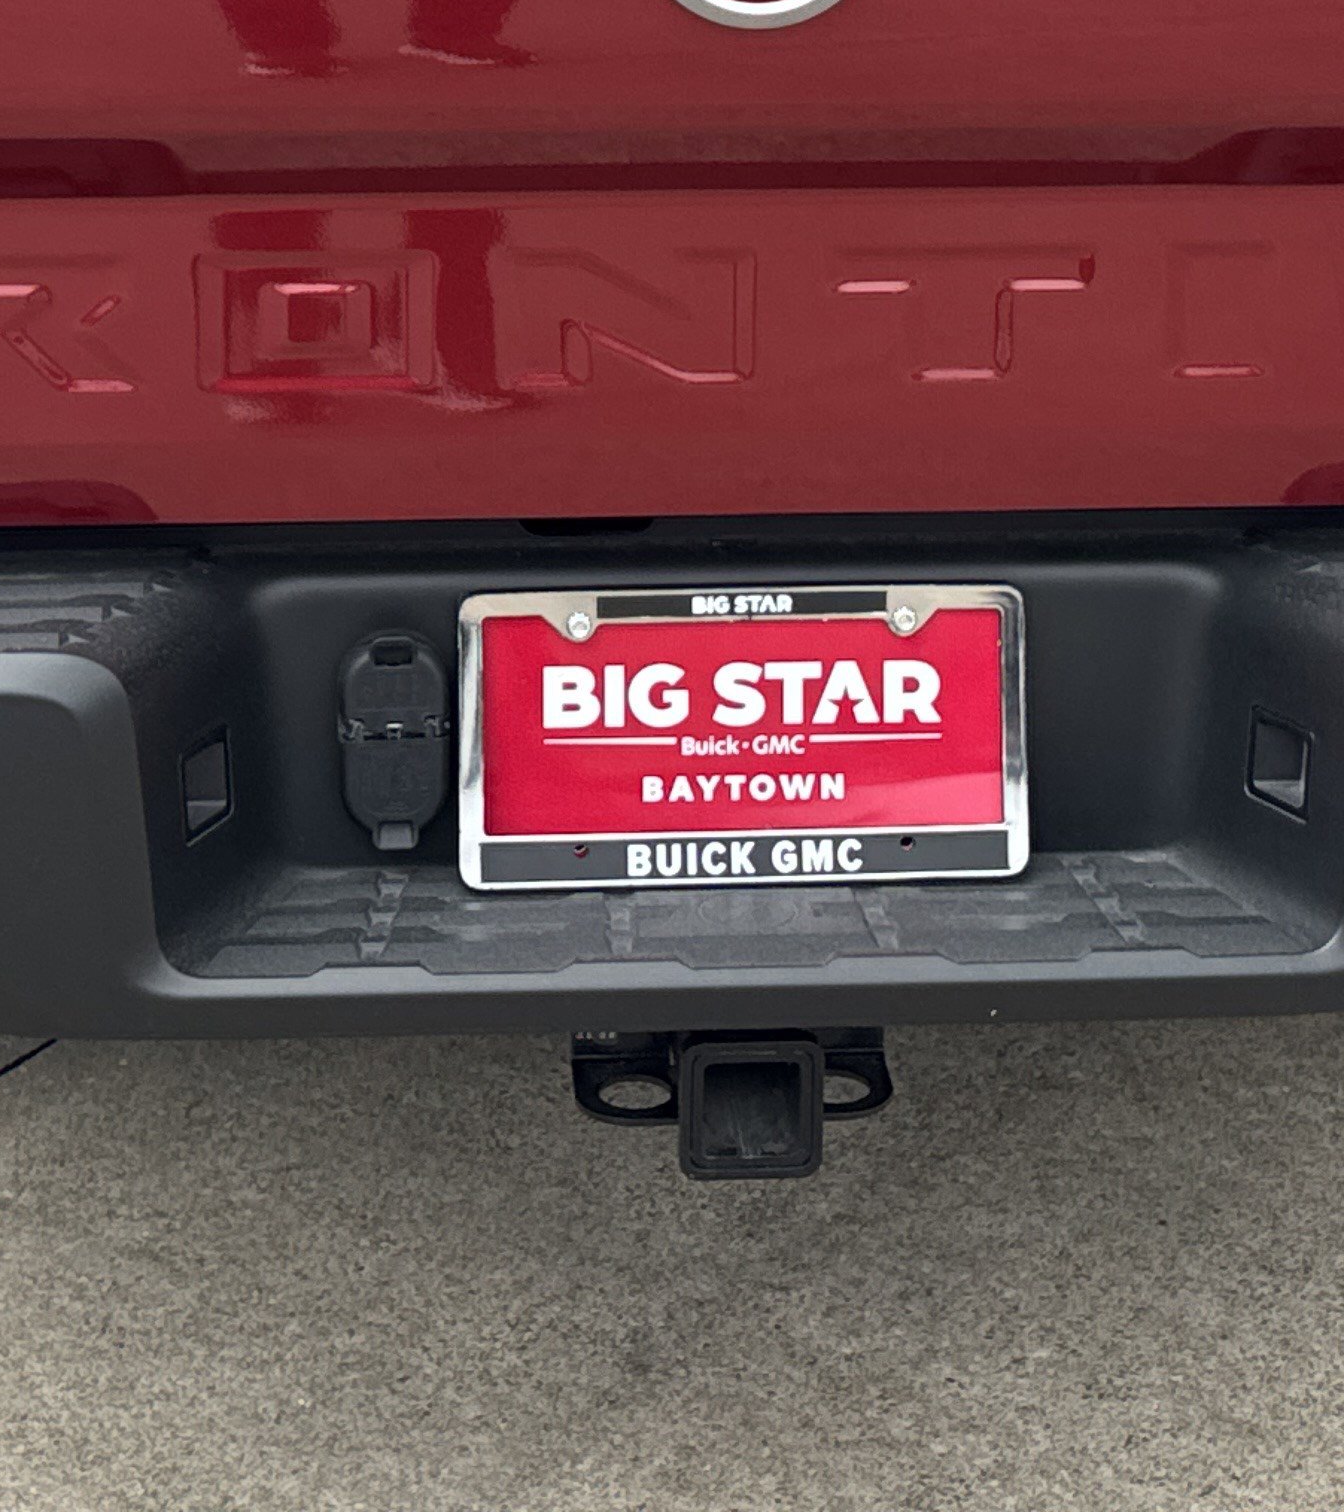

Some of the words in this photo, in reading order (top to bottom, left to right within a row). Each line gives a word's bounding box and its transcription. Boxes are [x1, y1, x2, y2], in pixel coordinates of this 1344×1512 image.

[692, 595, 731, 615] BIG
[733, 594, 793, 614] STAR
[541, 662, 690, 729] BIG
[712, 659, 943, 727] STAR
[641, 773, 846, 803] BAYTOWN
[626, 841, 756, 877] BUICK
[772, 838, 863, 873] GMC
